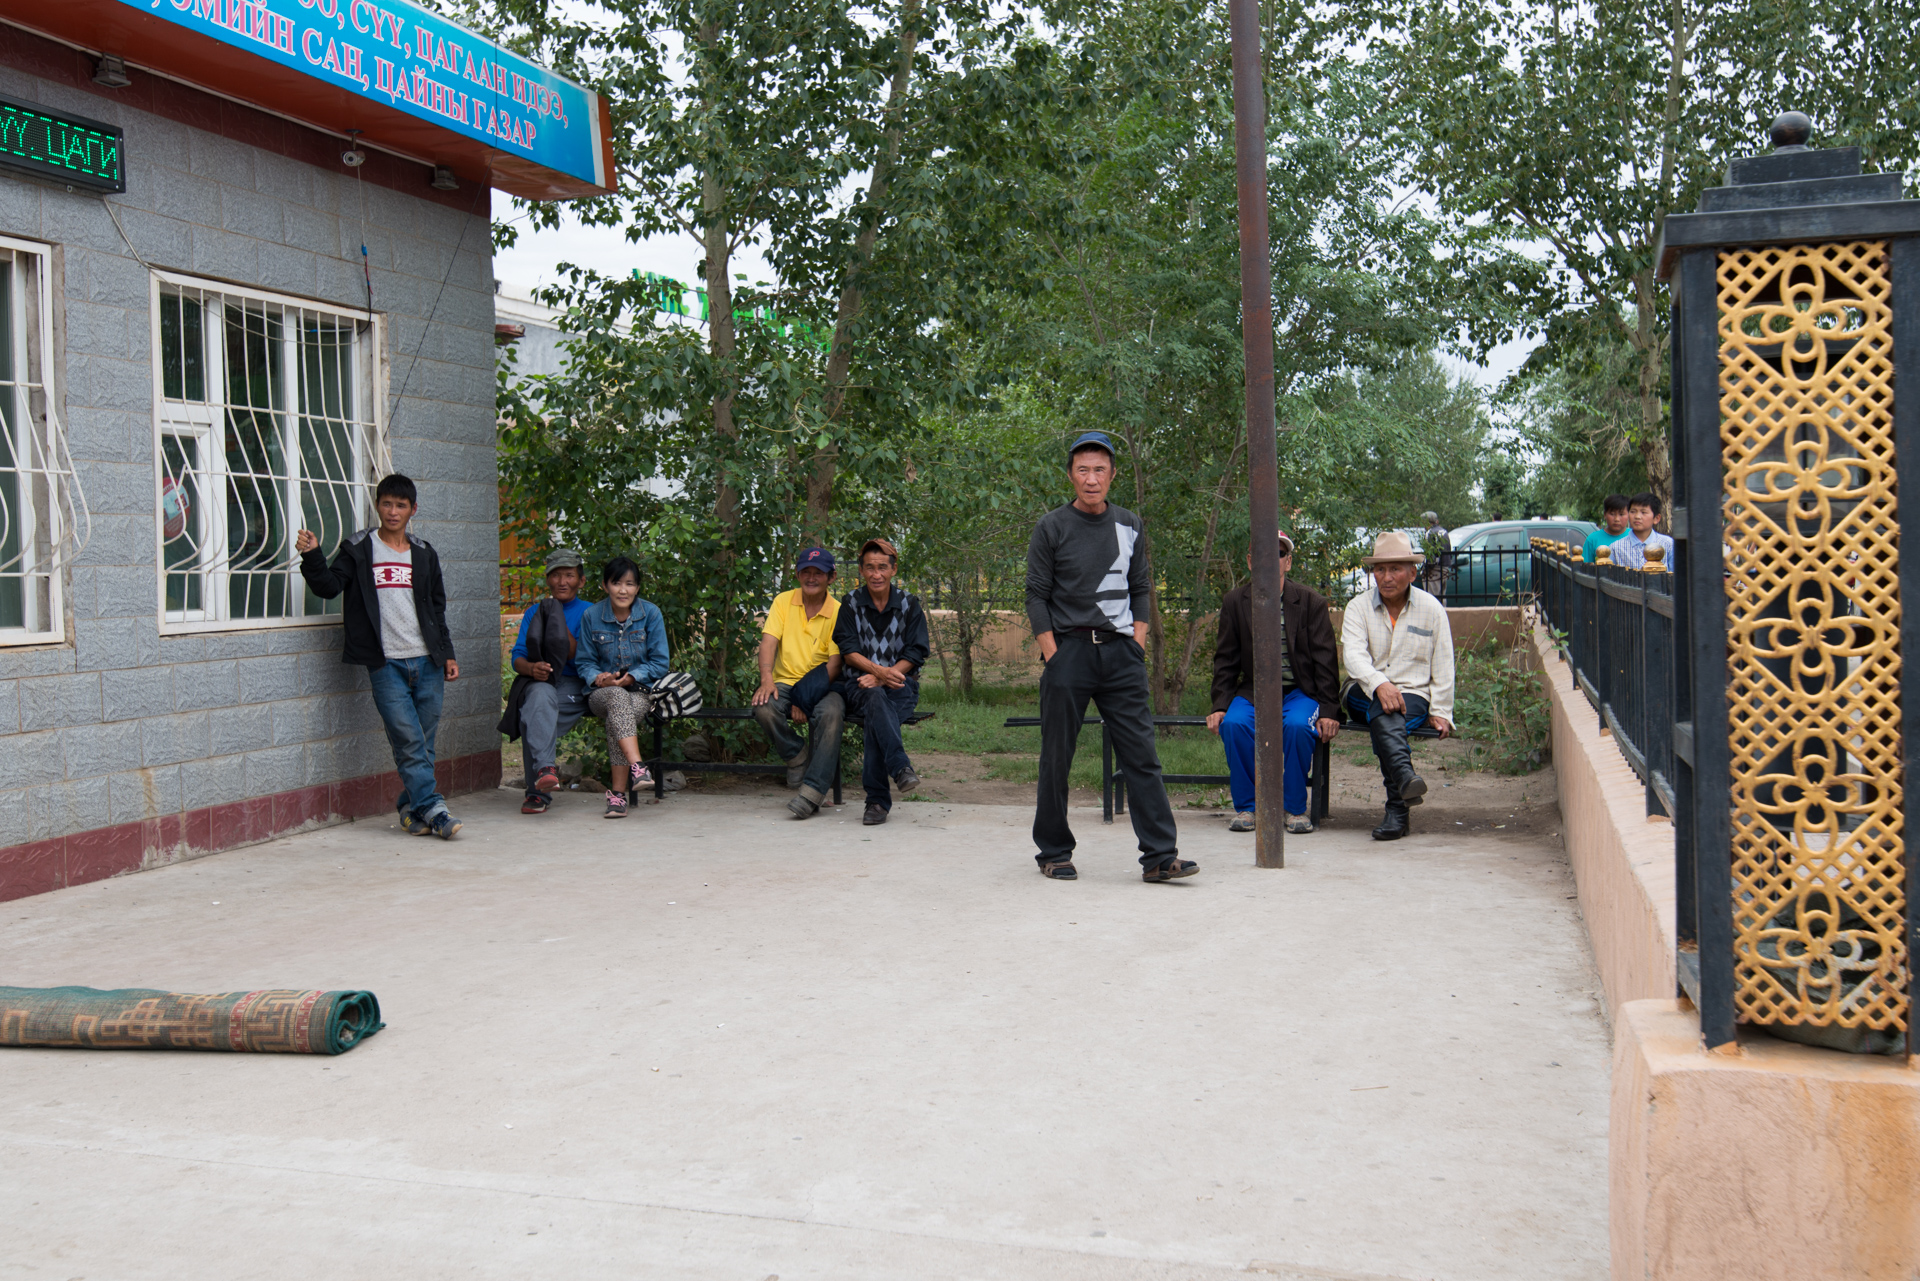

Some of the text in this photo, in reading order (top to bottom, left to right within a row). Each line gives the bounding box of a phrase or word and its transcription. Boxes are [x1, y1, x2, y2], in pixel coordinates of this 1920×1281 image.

[170, 0, 537, 150] МИЙН САН, ЦАЙНЫ ГАЗАР
[414, 25, 509, 98] ЦАГААН
[510, 71, 569, 129] ИДЭЭ,
